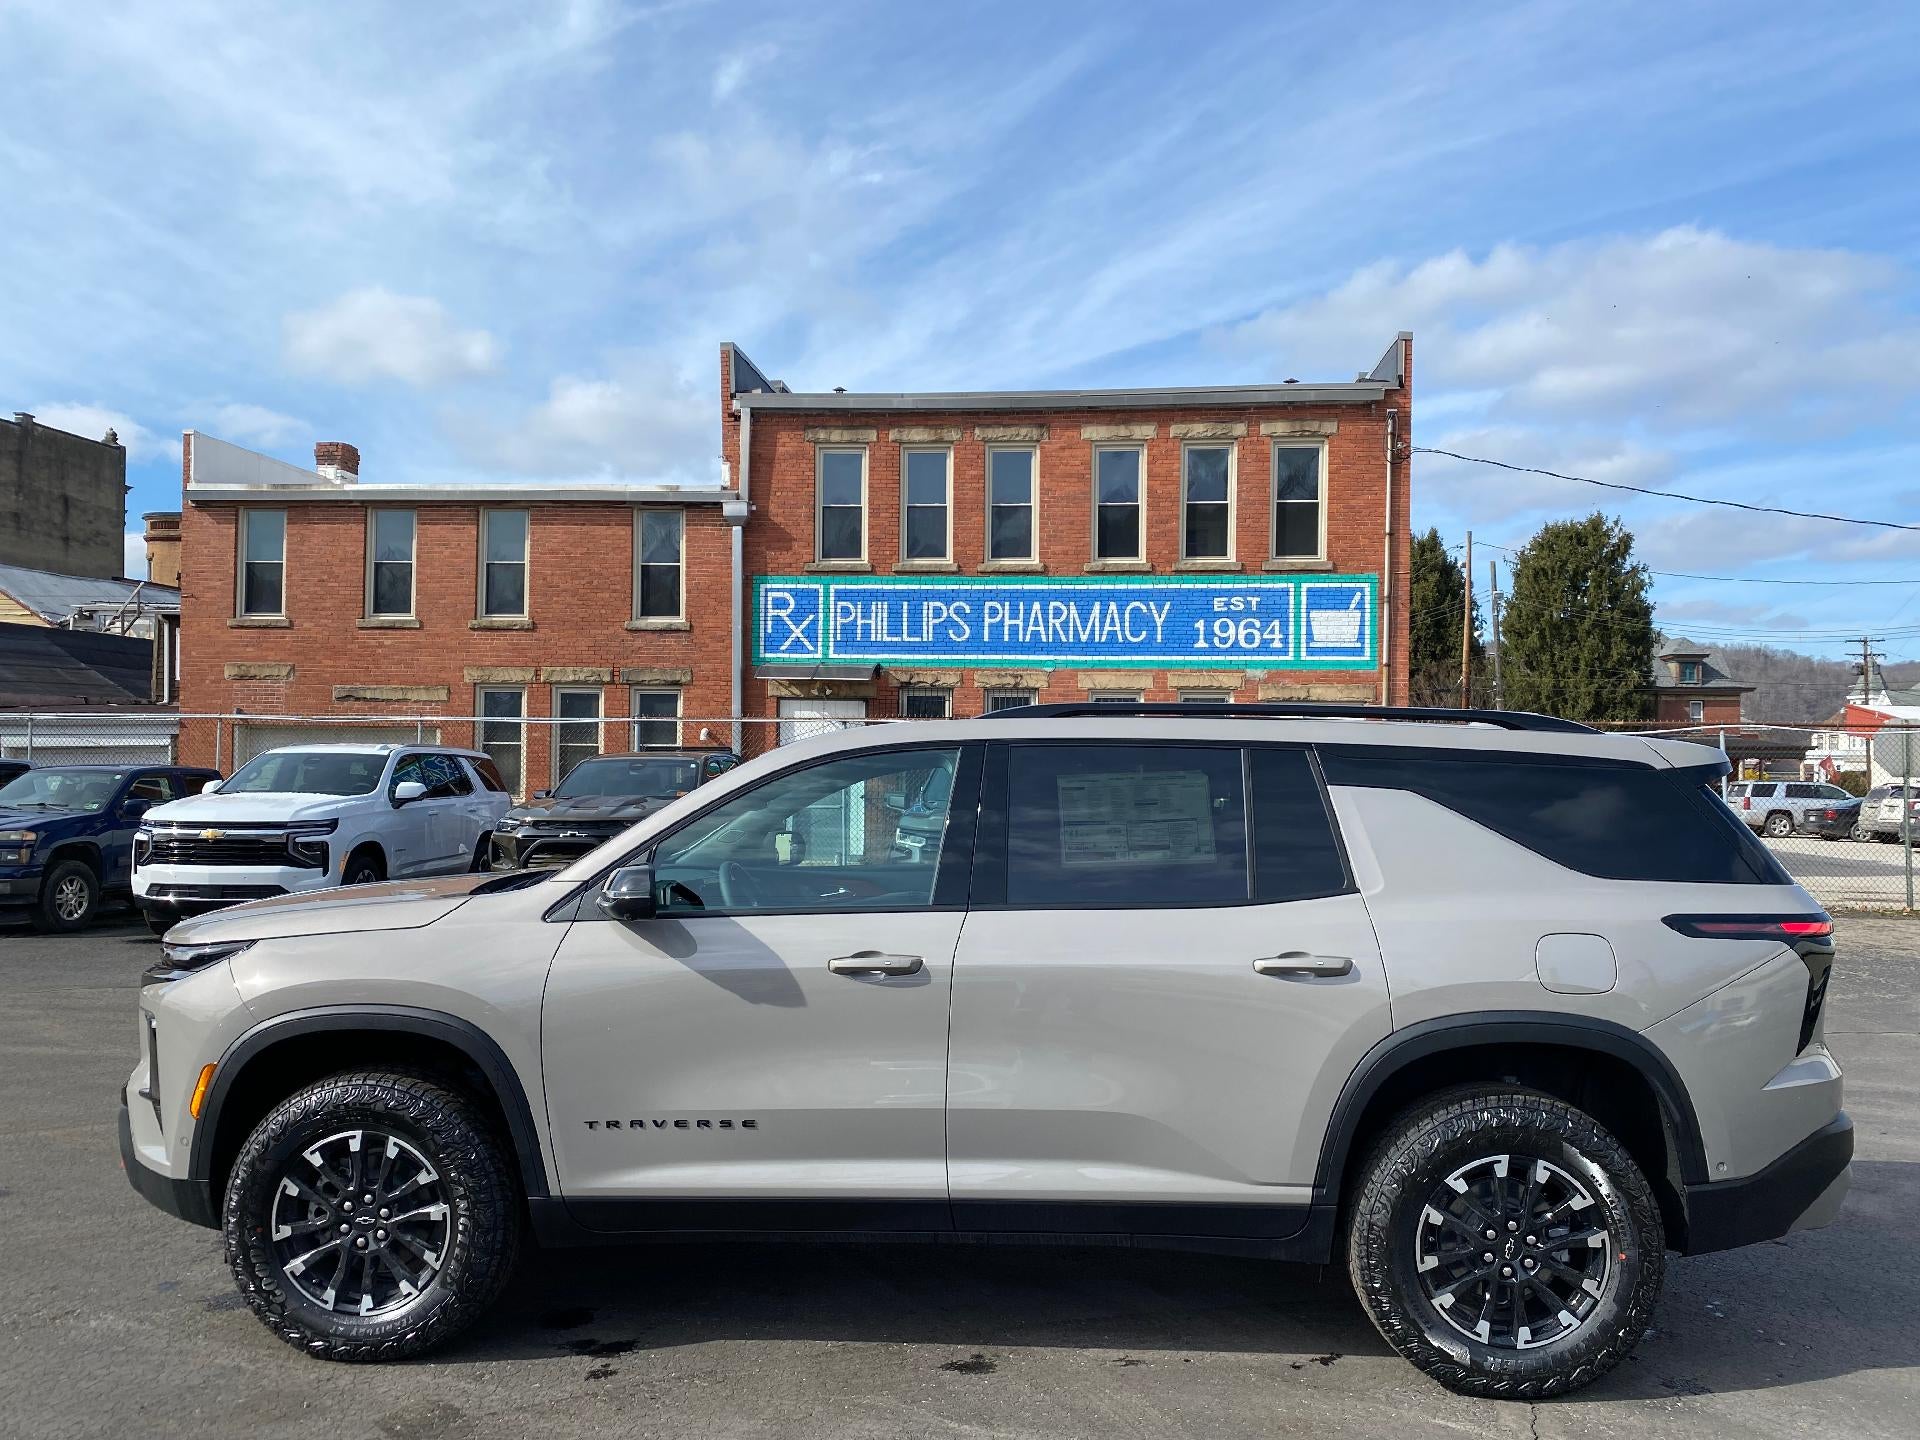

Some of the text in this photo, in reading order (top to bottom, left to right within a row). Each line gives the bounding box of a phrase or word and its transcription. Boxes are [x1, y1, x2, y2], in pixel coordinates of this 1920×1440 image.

[1213, 596, 1261, 612] EST
[836, 600, 1171, 643] PHILLIPS PHARMACY
[1193, 617, 1284, 649] 1964
[583, 1119, 757, 1130] TRAVERSE
